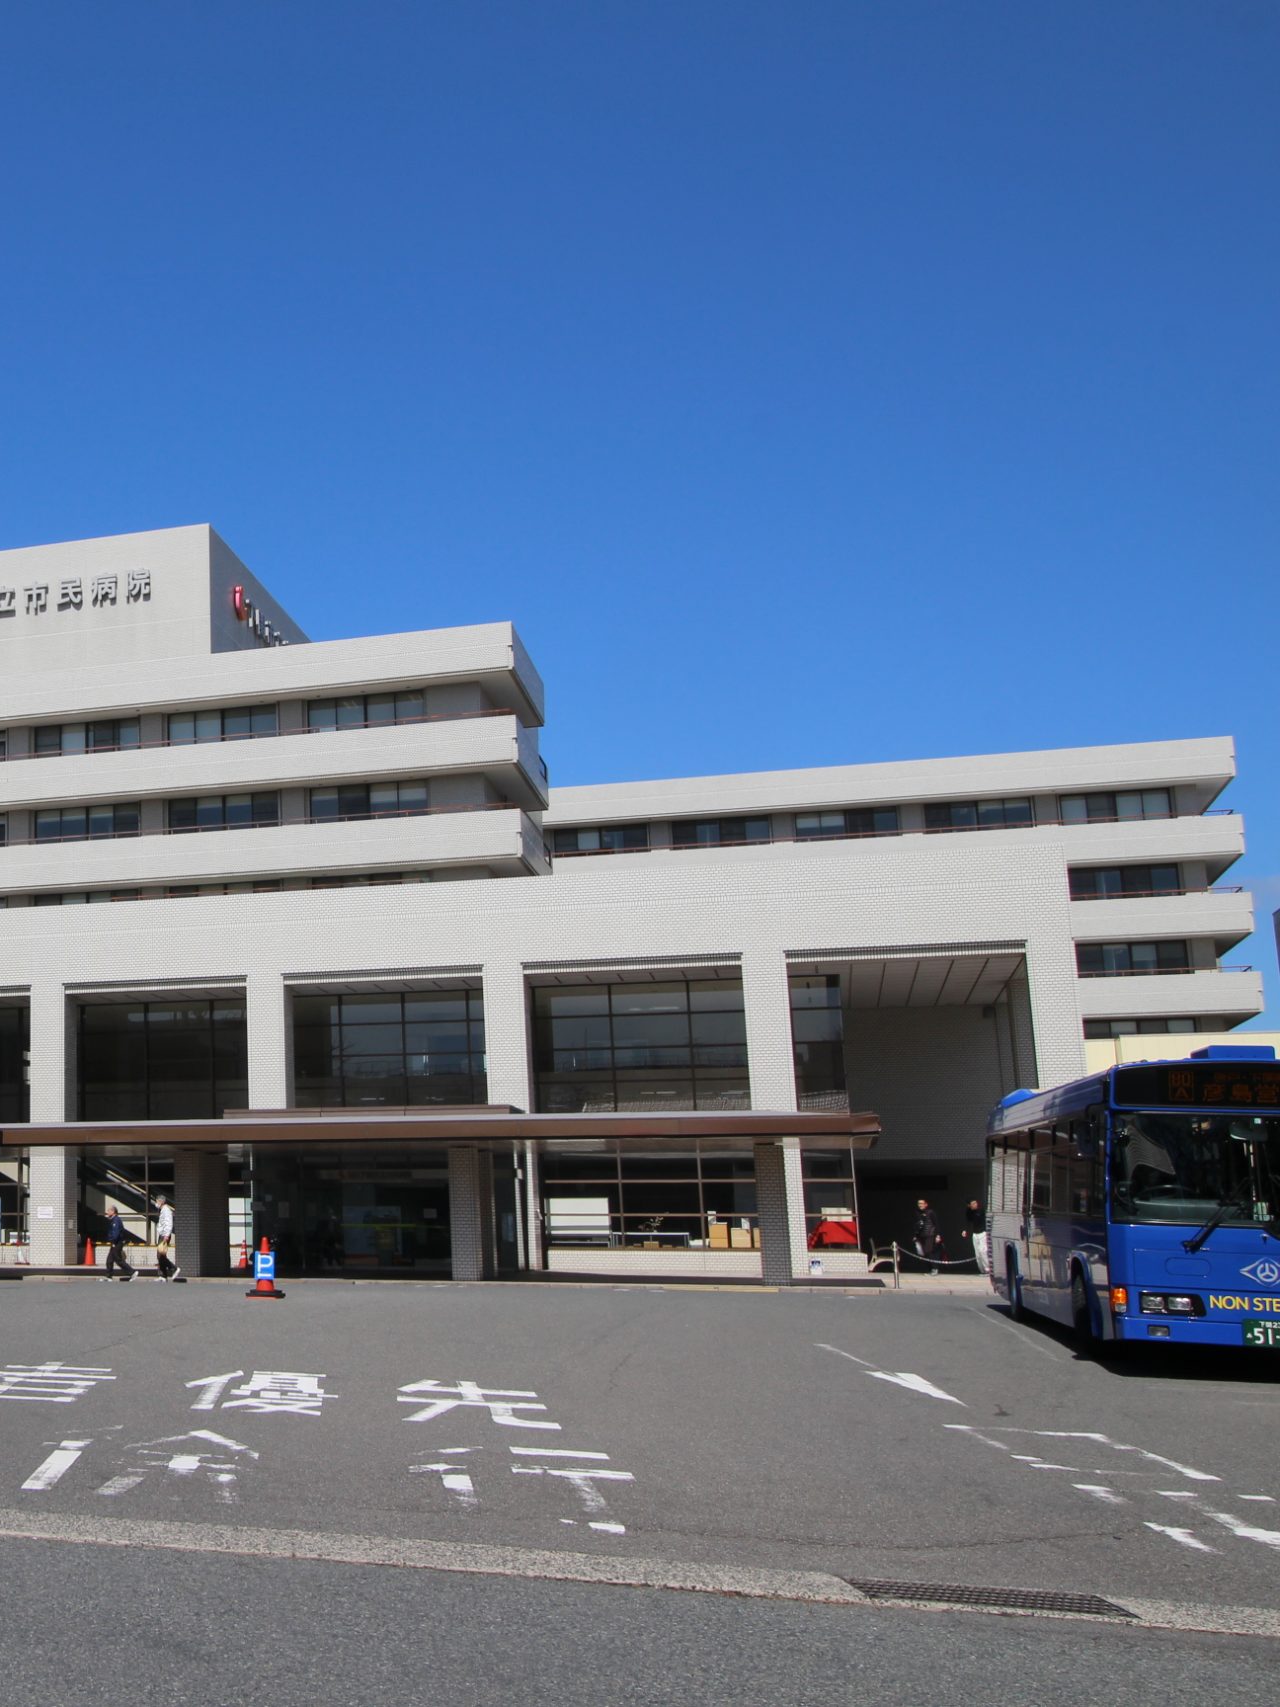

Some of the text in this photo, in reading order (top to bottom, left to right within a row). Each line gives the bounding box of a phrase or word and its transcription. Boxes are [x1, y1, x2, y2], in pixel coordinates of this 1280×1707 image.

[257, 1254, 274, 1273] P
[1209, 1294, 1280, 1313] NON STE
